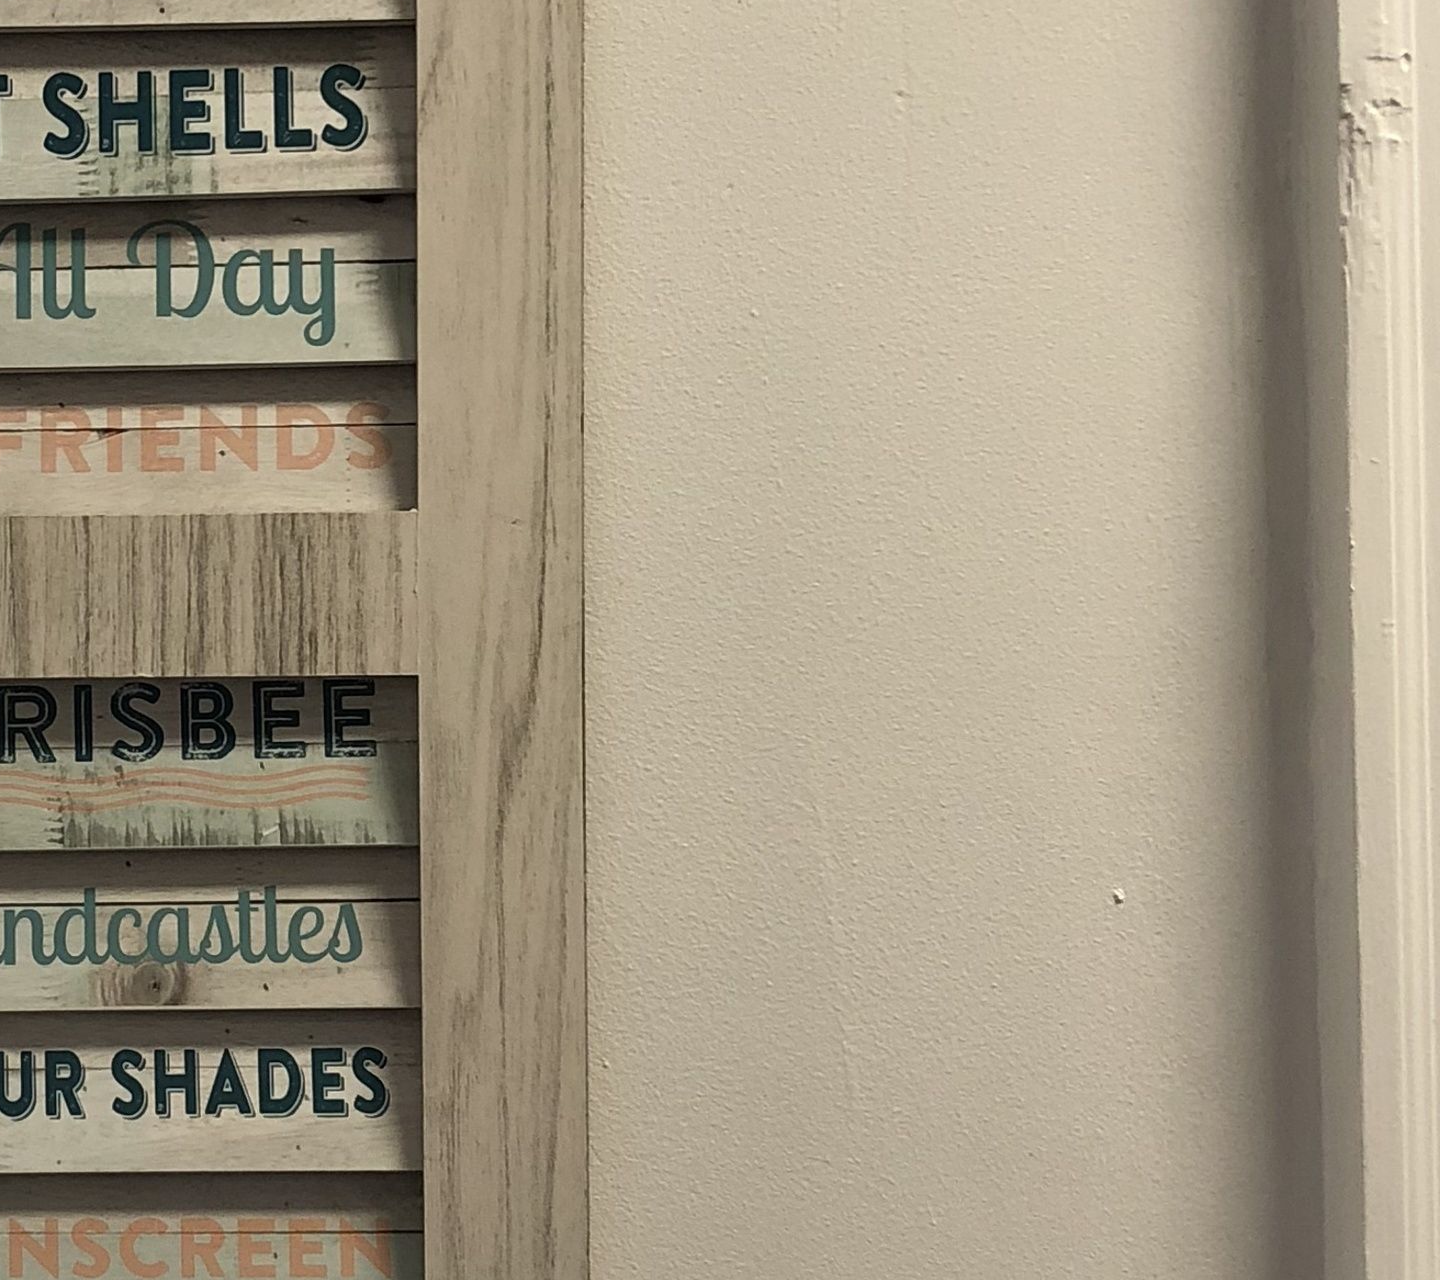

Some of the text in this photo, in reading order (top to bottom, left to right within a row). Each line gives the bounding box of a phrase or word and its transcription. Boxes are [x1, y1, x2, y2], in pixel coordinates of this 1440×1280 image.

[42, 64, 368, 159] SHELLS
[127, 219, 338, 347] Day
[111, 1046, 392, 1119] SHADES
